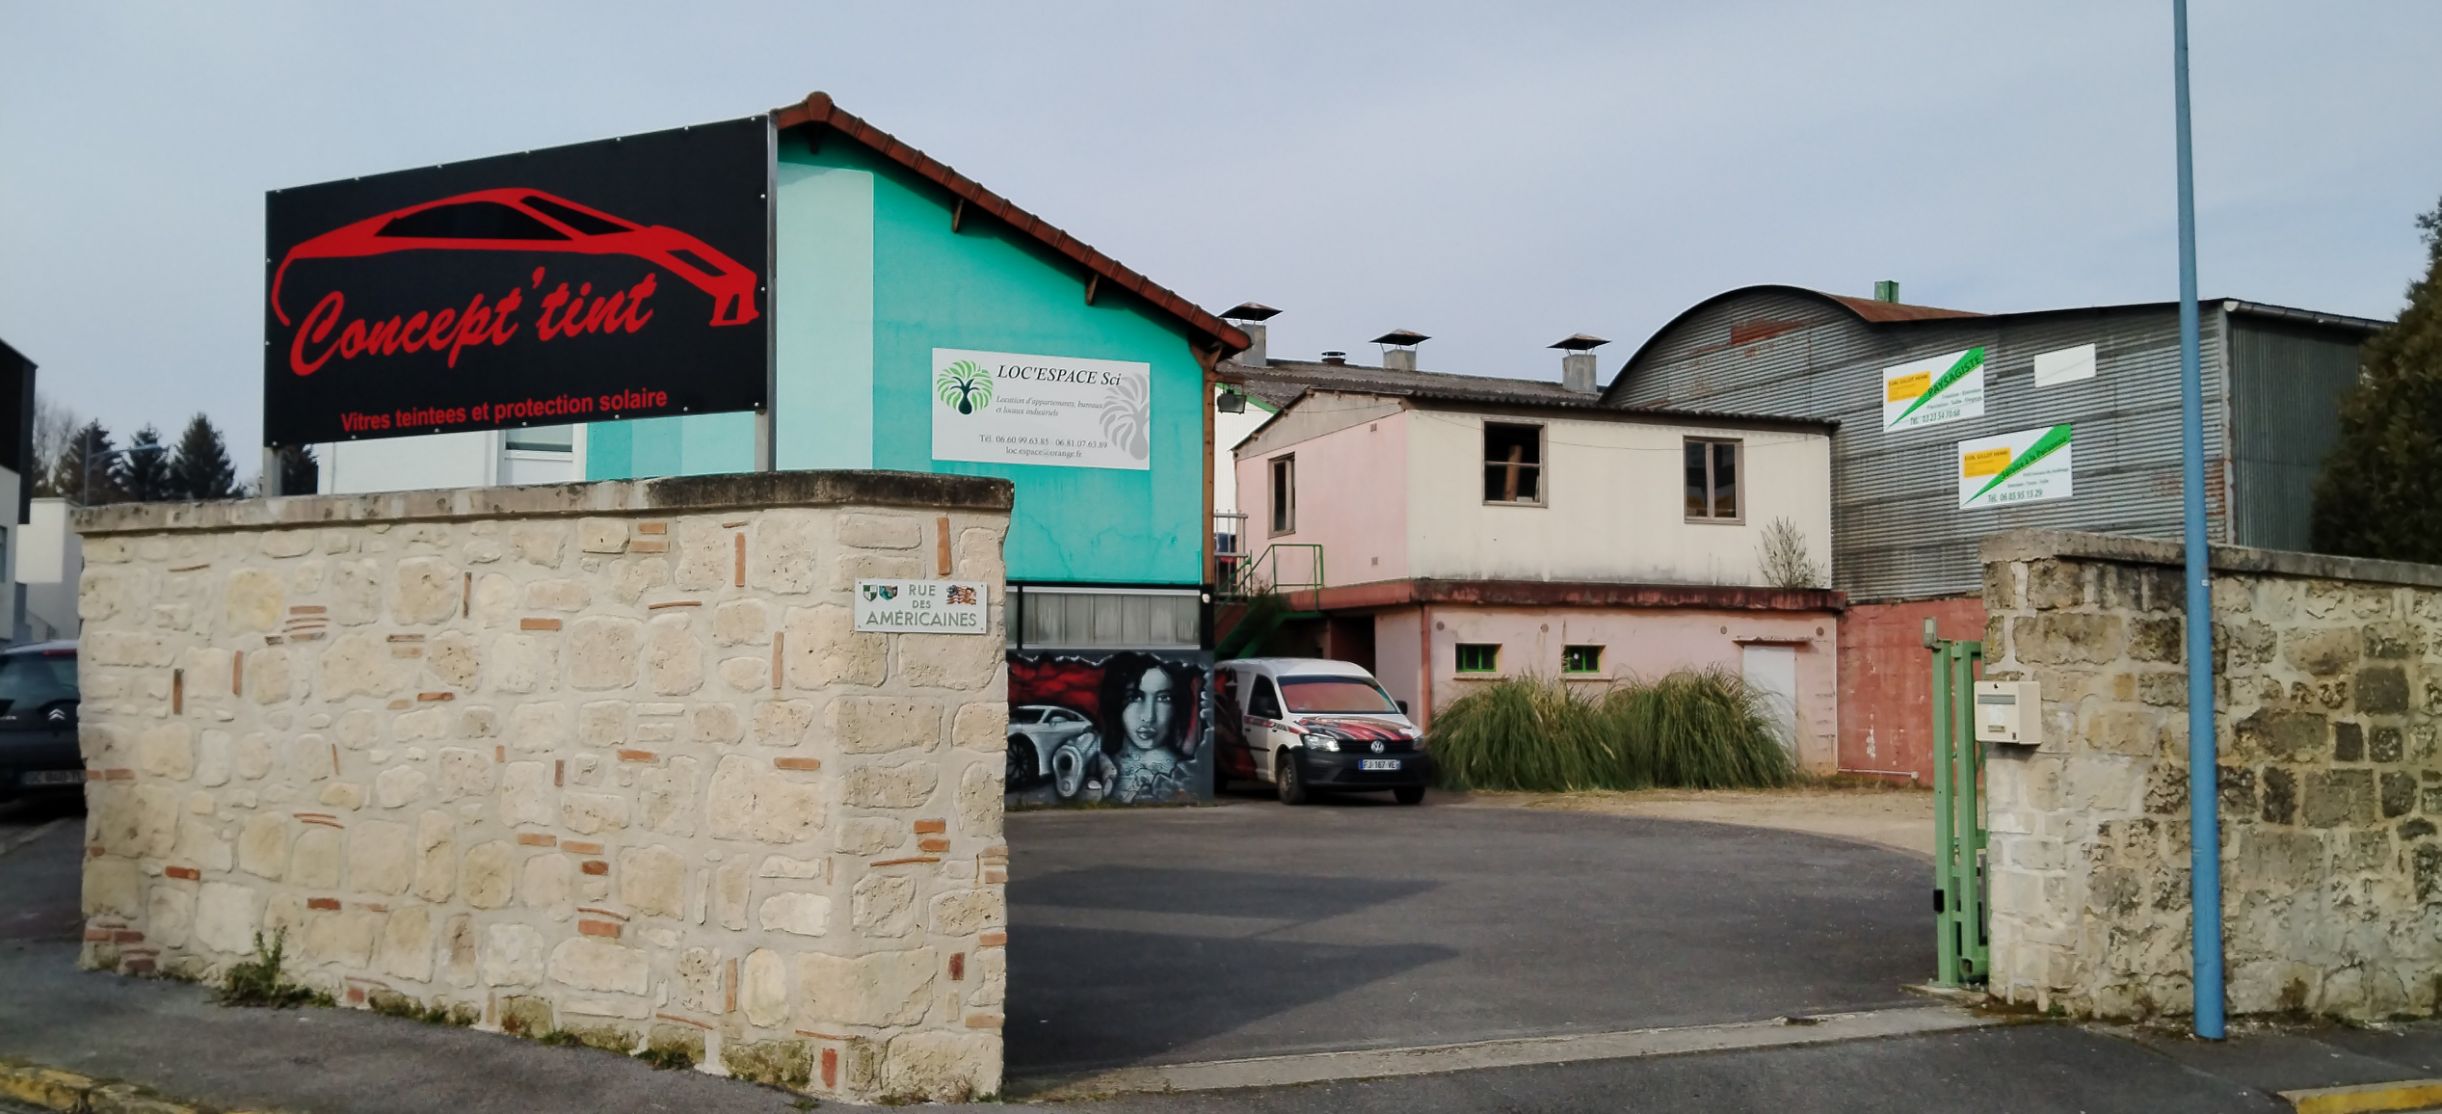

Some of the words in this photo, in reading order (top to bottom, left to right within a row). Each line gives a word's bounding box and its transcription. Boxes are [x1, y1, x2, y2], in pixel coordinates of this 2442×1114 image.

[997, 365, 1098, 384] LOC'ESPACE
[1101, 372, 1121, 386] Sci
[1927, 355, 1981, 397] PAYSAGISTE
[341, 413, 391, 432] Vitres
[396, 408, 467, 427] teintees
[472, 403, 489, 421] et
[494, 396, 593, 423] protection
[600, 388, 667, 411] solaire
[908, 584, 936, 597] RUE
[912, 600, 931, 609] DES
[866, 610, 977, 627] AMÉRICAINES
